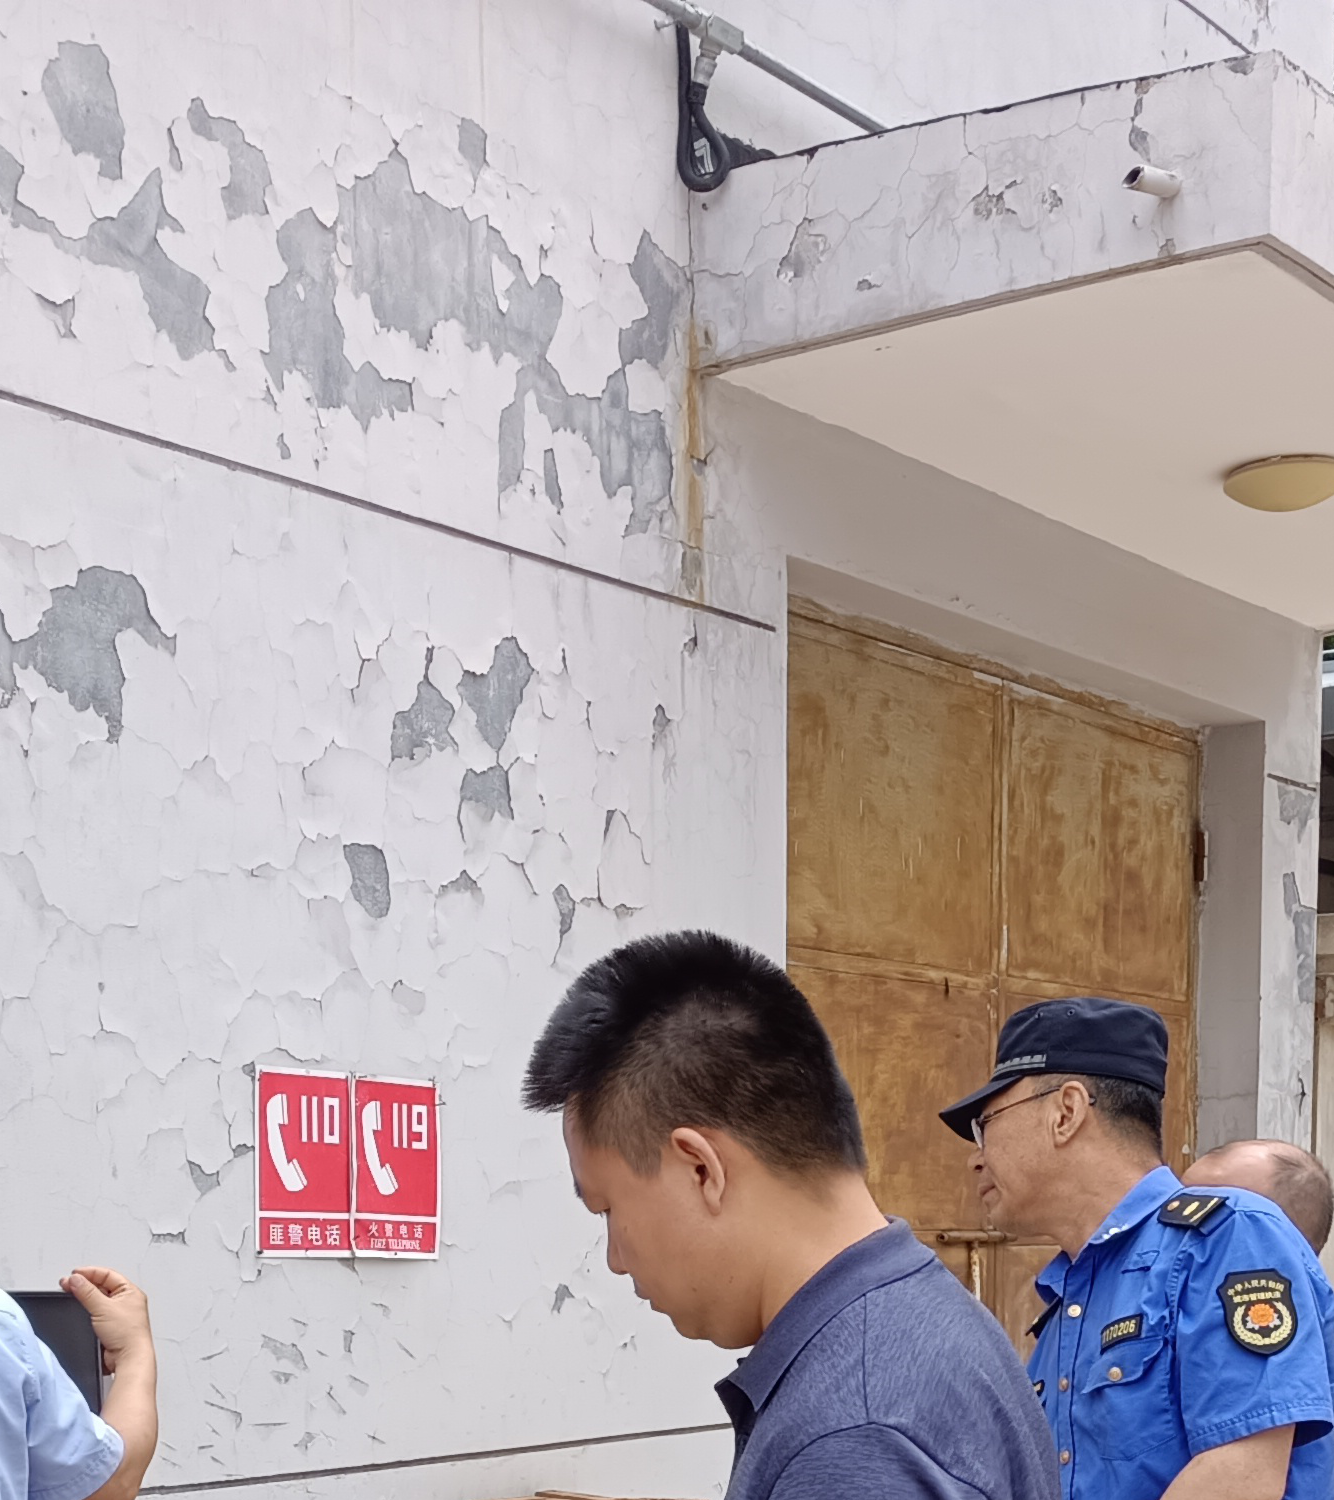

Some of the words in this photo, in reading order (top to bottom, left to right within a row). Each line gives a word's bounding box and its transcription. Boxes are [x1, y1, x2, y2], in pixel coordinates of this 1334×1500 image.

[300, 1094, 340, 1144] 110
[392, 1102, 428, 1149] 119
[269, 1223, 341, 1246] 匪警电话
[367, 1222, 423, 1239] 火警电话
